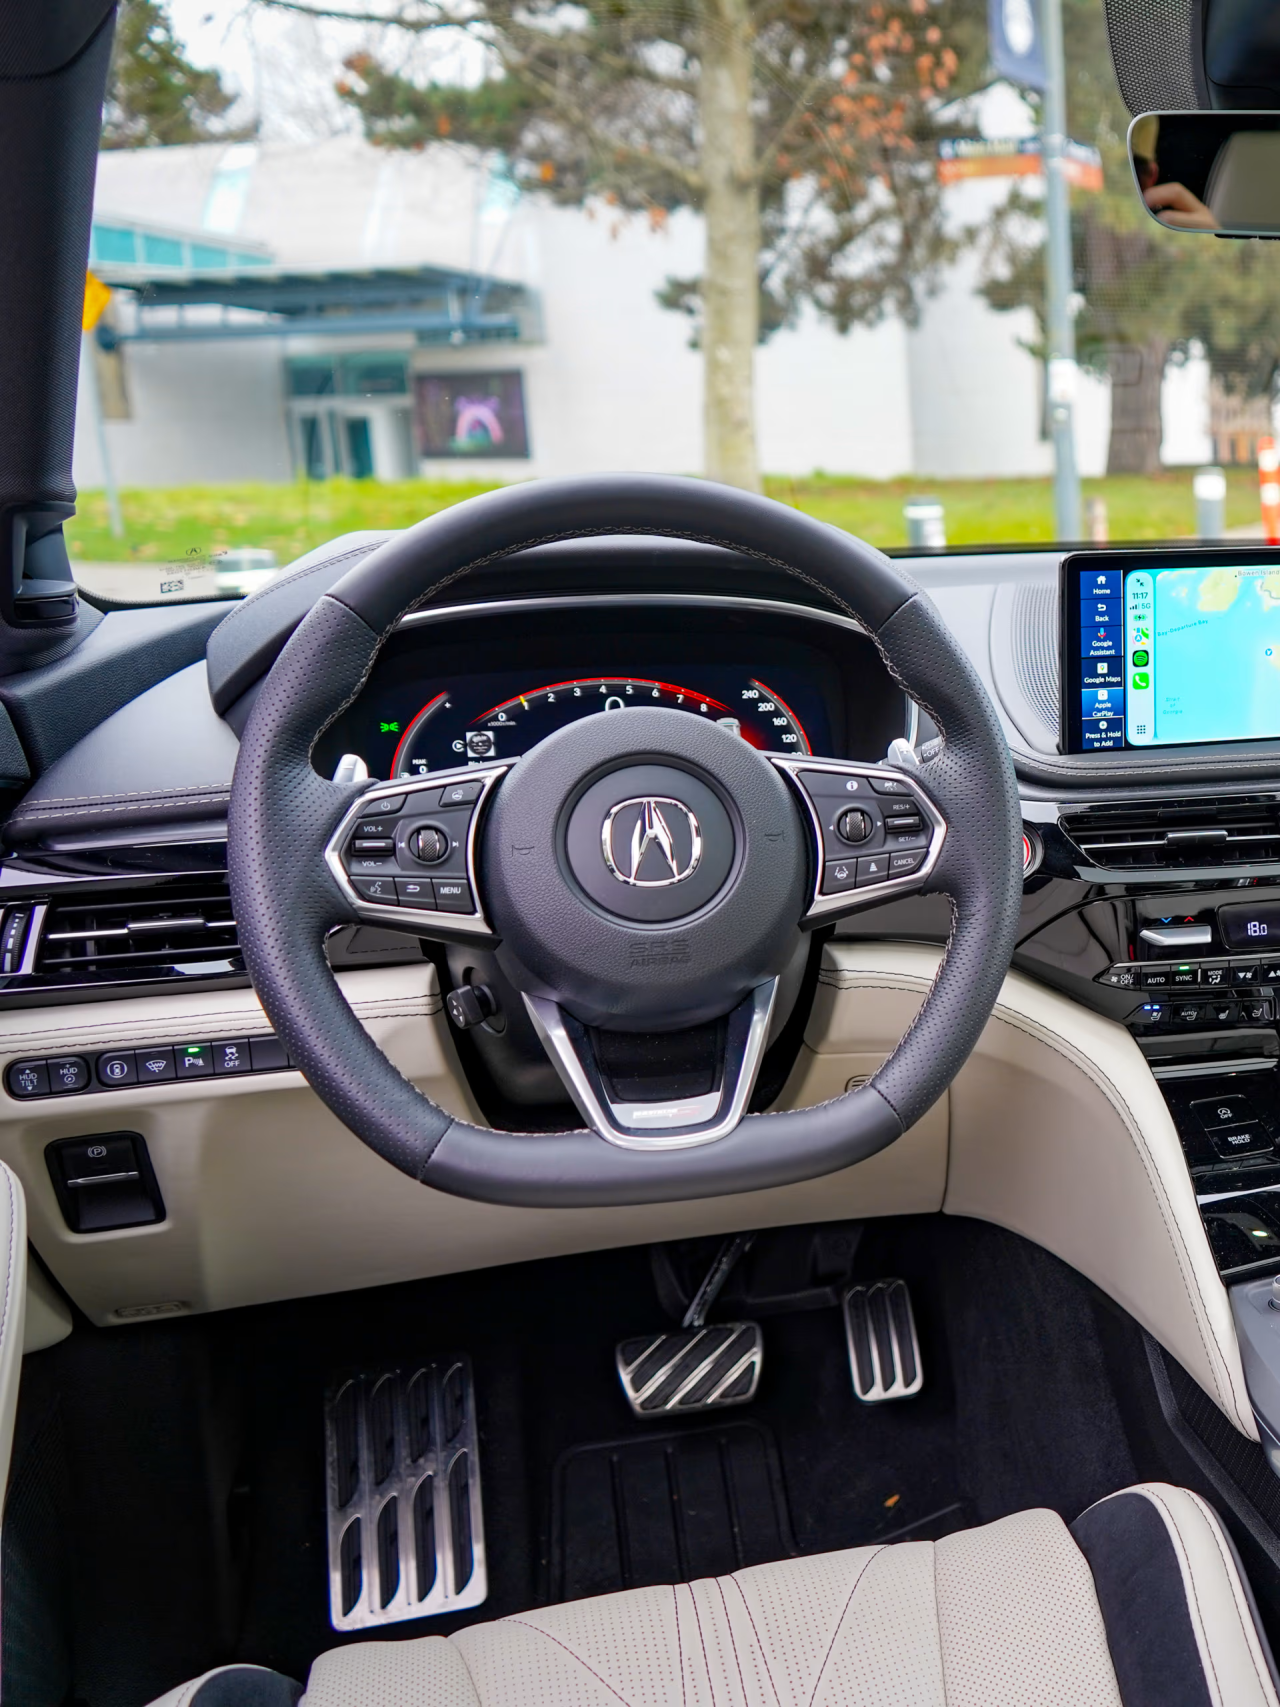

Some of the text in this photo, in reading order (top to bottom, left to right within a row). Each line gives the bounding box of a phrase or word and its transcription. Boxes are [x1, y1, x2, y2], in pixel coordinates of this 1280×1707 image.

[1132, 592, 1149, 600] 11:17
[1141, 602, 1151, 610] 5G
[1092, 640, 1113, 648] Google
[573, 687, 582, 697] 3
[599, 685, 607, 693] 4
[625, 685, 634, 694] 5
[651, 688, 660, 697] 6
[547, 693, 555, 702] 2
[676, 694, 684, 703] 7
[741, 689, 759, 699] 240
[524, 702, 530, 711] 1
[700, 703, 708, 712] 8
[758, 702, 775, 712] 200
[498, 712, 506, 721] 0
[772, 717, 787, 726] 160
[781, 733, 797, 743] 120
[926, 746, 940, 757] OFF
[419, 765, 427, 774] 0
[893, 857, 915, 866] CANCEL
[440, 886, 461, 895] MENU
[1247, 921, 1268, 936] 18.0
[224, 1059, 240, 1068] OFF
[59, 1066, 78, 1075] HUD
[19, 1072, 38, 1081] HUD
[20, 1079, 38, 1087] TILT
